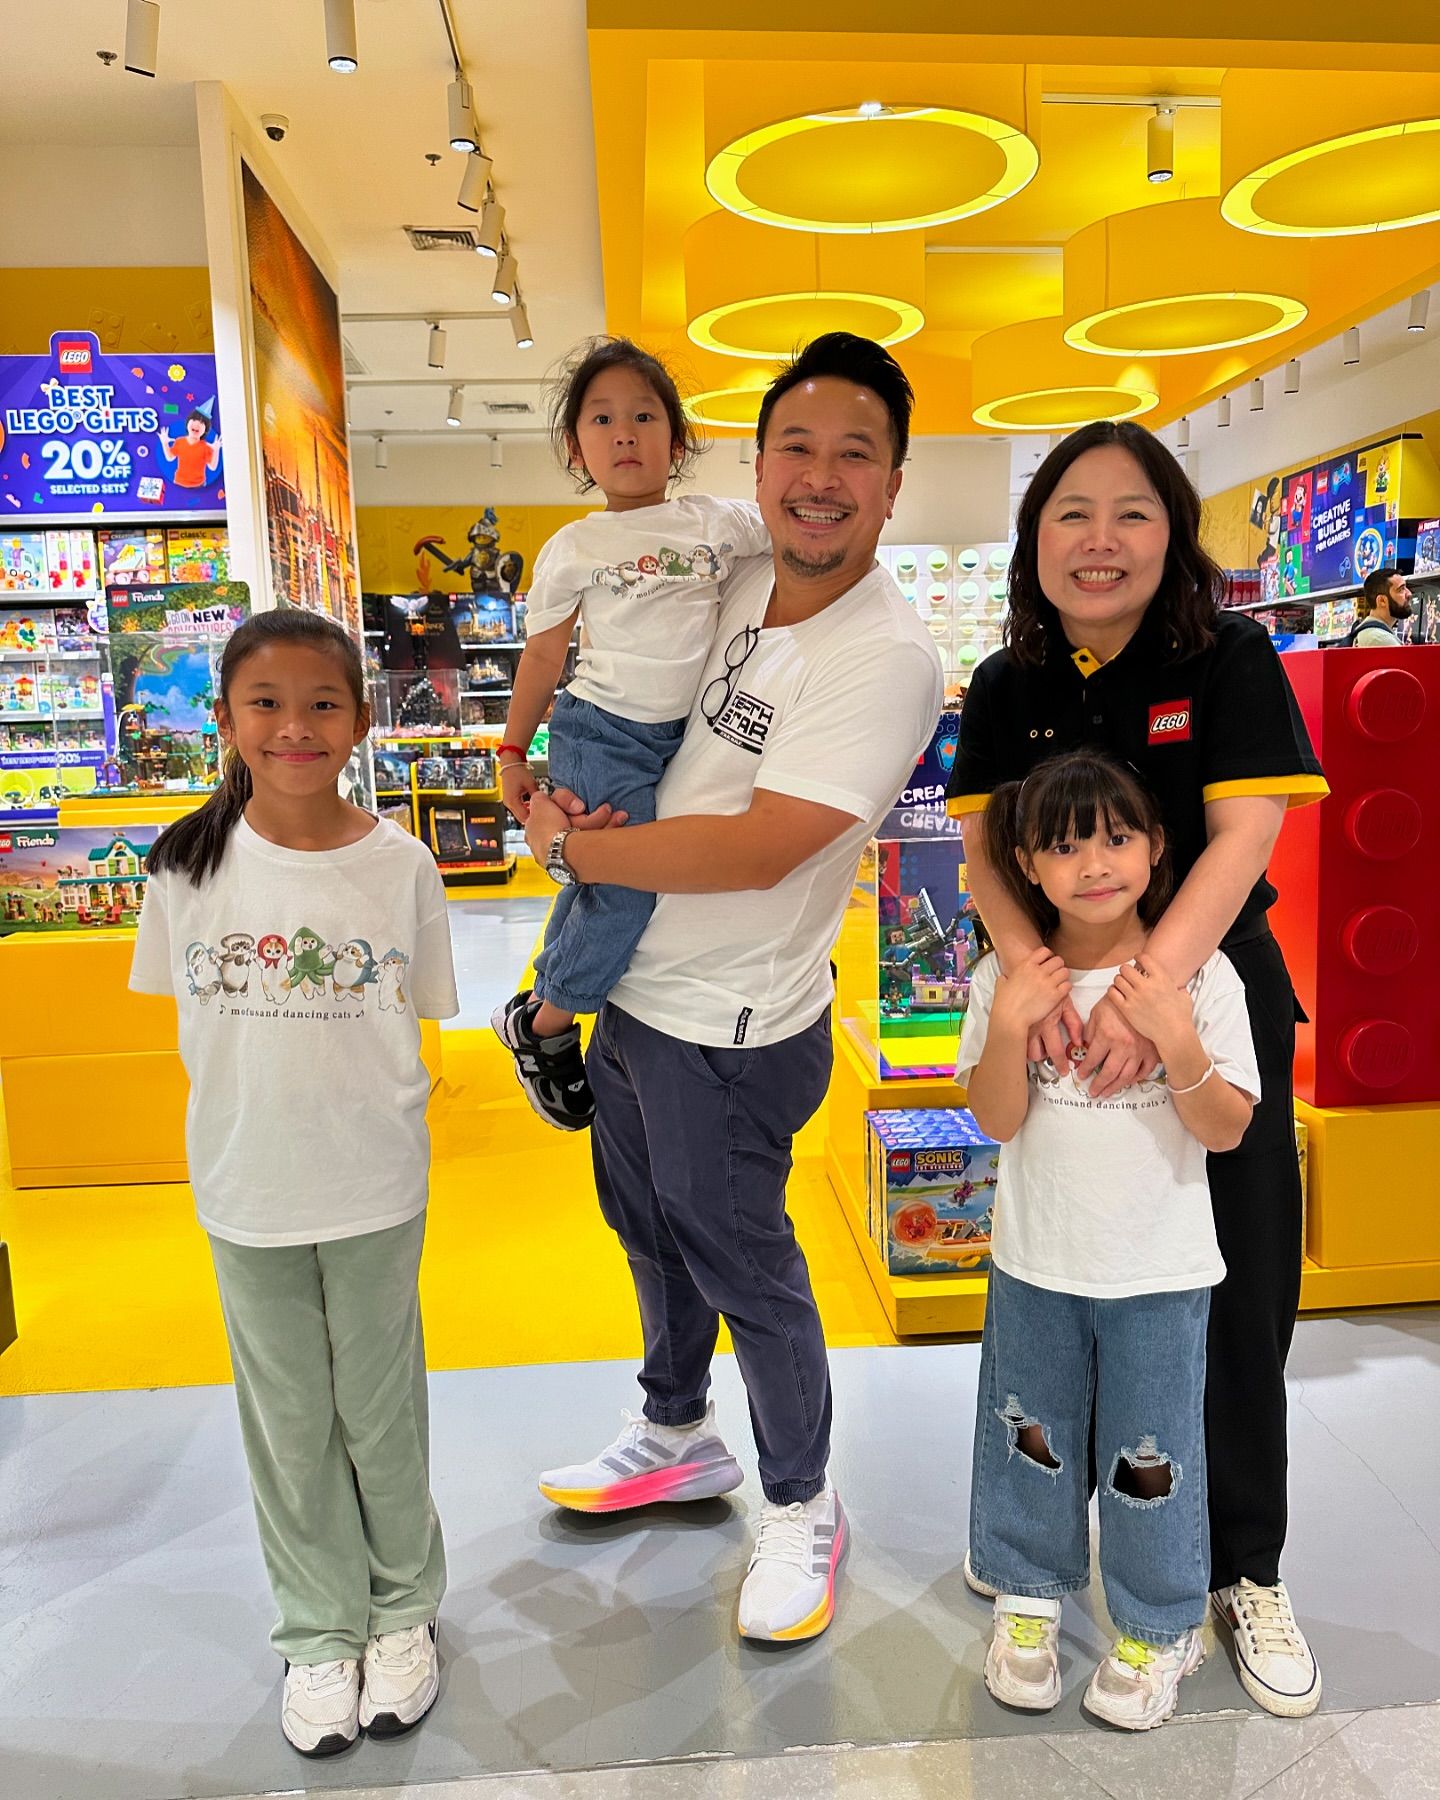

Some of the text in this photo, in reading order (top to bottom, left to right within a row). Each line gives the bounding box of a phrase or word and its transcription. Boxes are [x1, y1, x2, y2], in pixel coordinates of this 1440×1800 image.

[61, 350, 90, 365] LEGO
[49, 386, 113, 409] BEST
[41, 439, 131, 480] 20% OFF
[50, 484, 100, 495] SELECTED
[1312, 498, 1351, 530] CREATIVE
[1317, 515, 1348, 542] BUILDS
[1315, 528, 1351, 554] FOR GAMERS
[131, 590, 165, 603] Friends
[193, 609, 225, 624] NEW
[721, 708, 769, 741] STAR
[1151, 711, 1189, 734] LEGO
[60, 752, 80, 764] 20%
[900, 784, 945, 804] CREA
[16, 833, 55, 848] Friends
[231, 1006, 351, 1020] mofusand dancing cats
[1096, 1099, 1138, 1111] dancing
[1141, 1099, 1159, 1109] cats
[917, 1152, 962, 1165] SONIC
